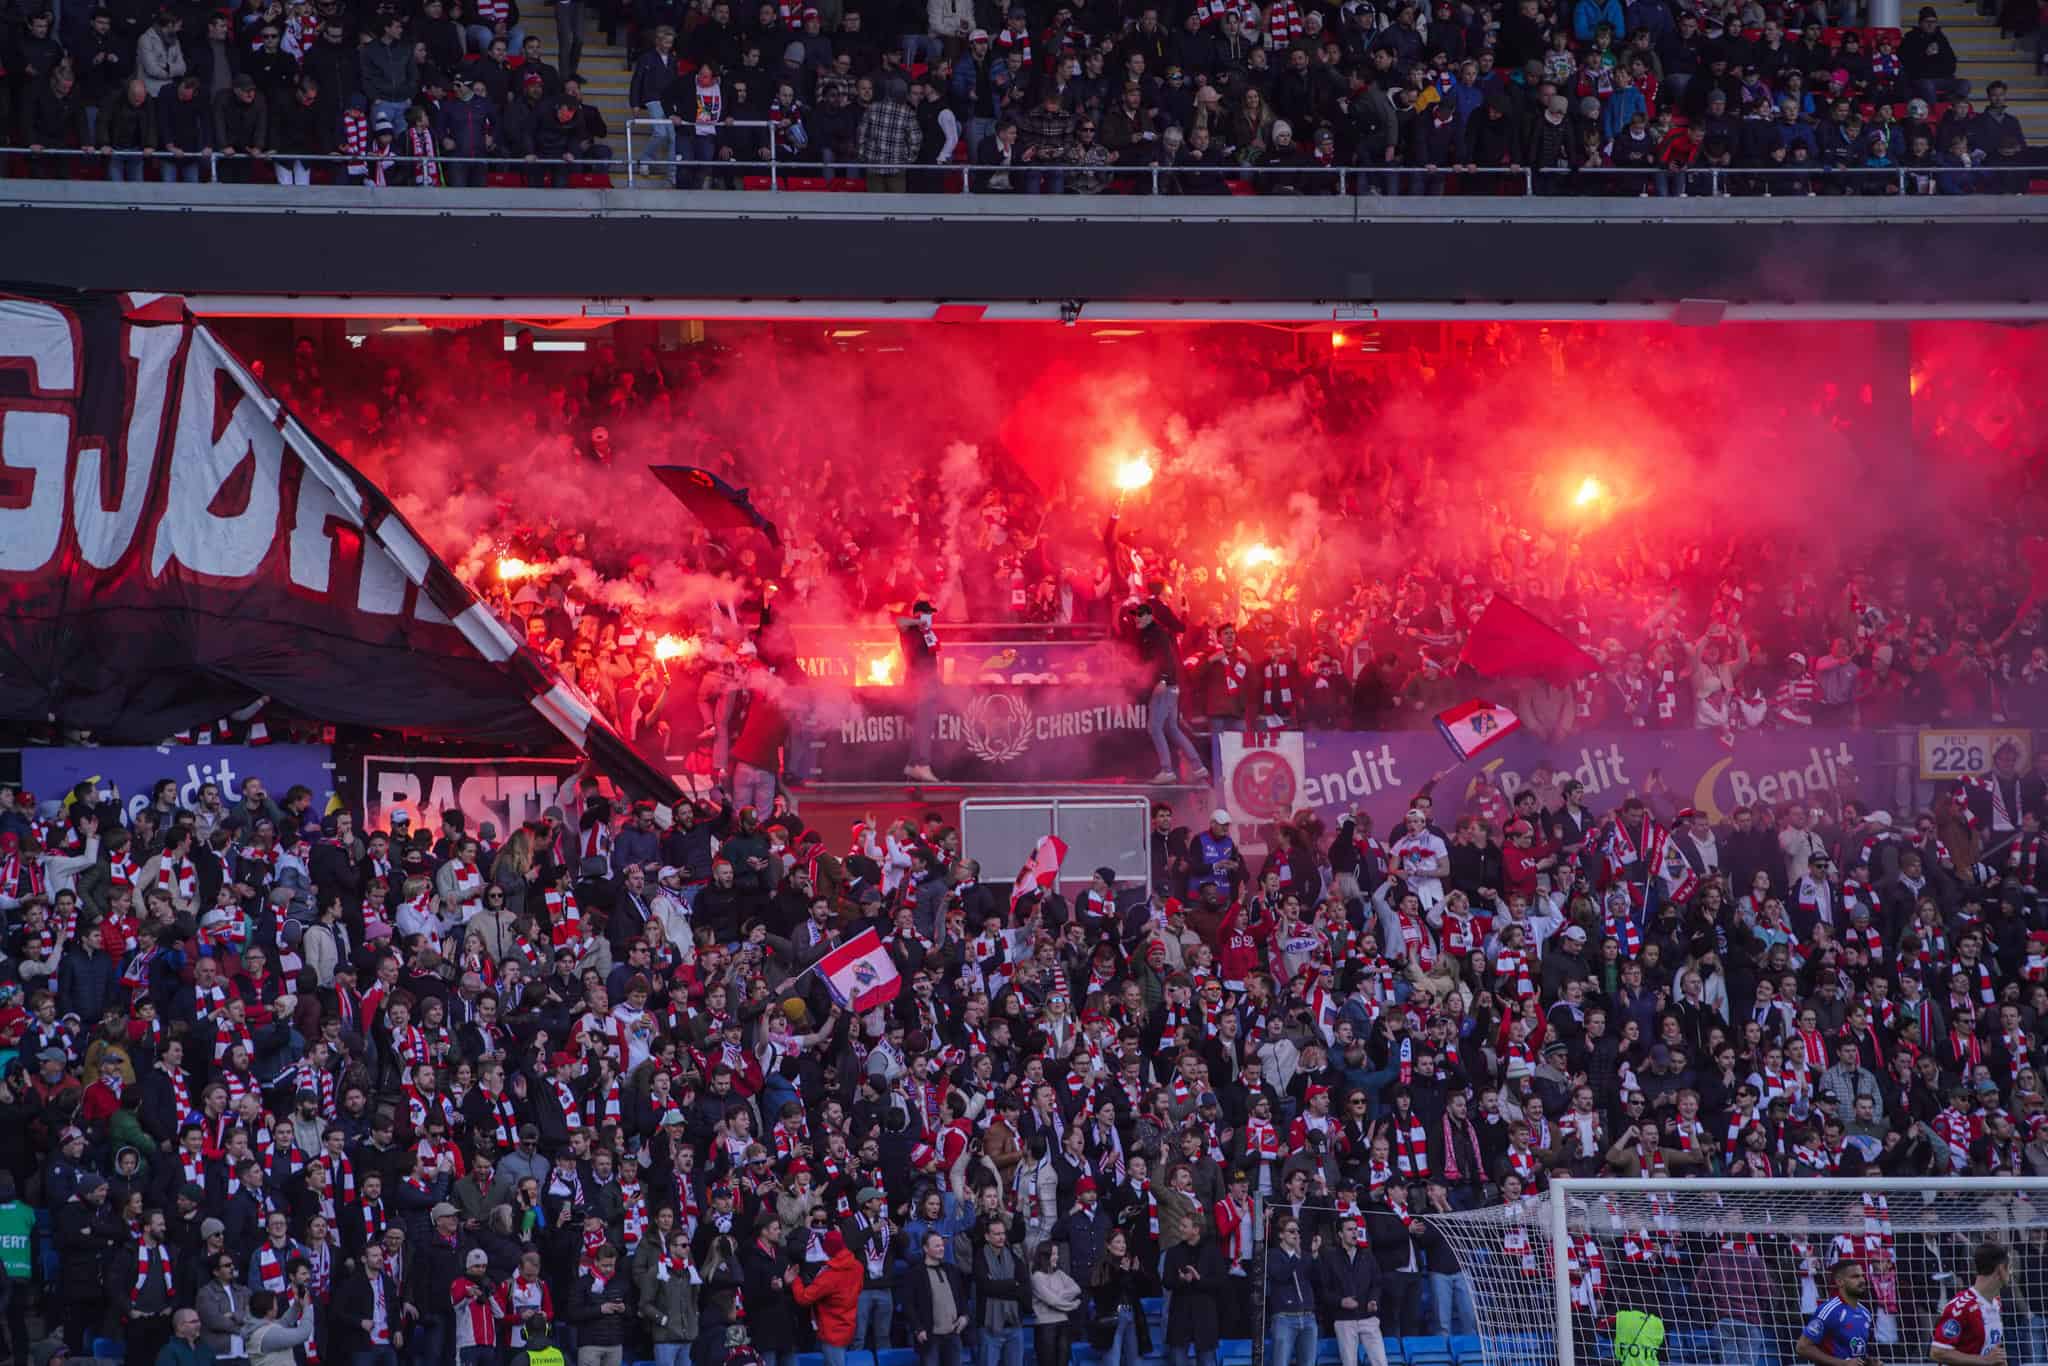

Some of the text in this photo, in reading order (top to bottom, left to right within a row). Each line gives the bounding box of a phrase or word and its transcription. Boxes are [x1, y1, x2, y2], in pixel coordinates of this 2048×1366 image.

[1036, 704, 1148, 740] CHRISTIANI
[1303, 744, 1402, 808] endit
[1729, 742, 1855, 806] Bendit
[0, 1234, 28, 1249] ERT
